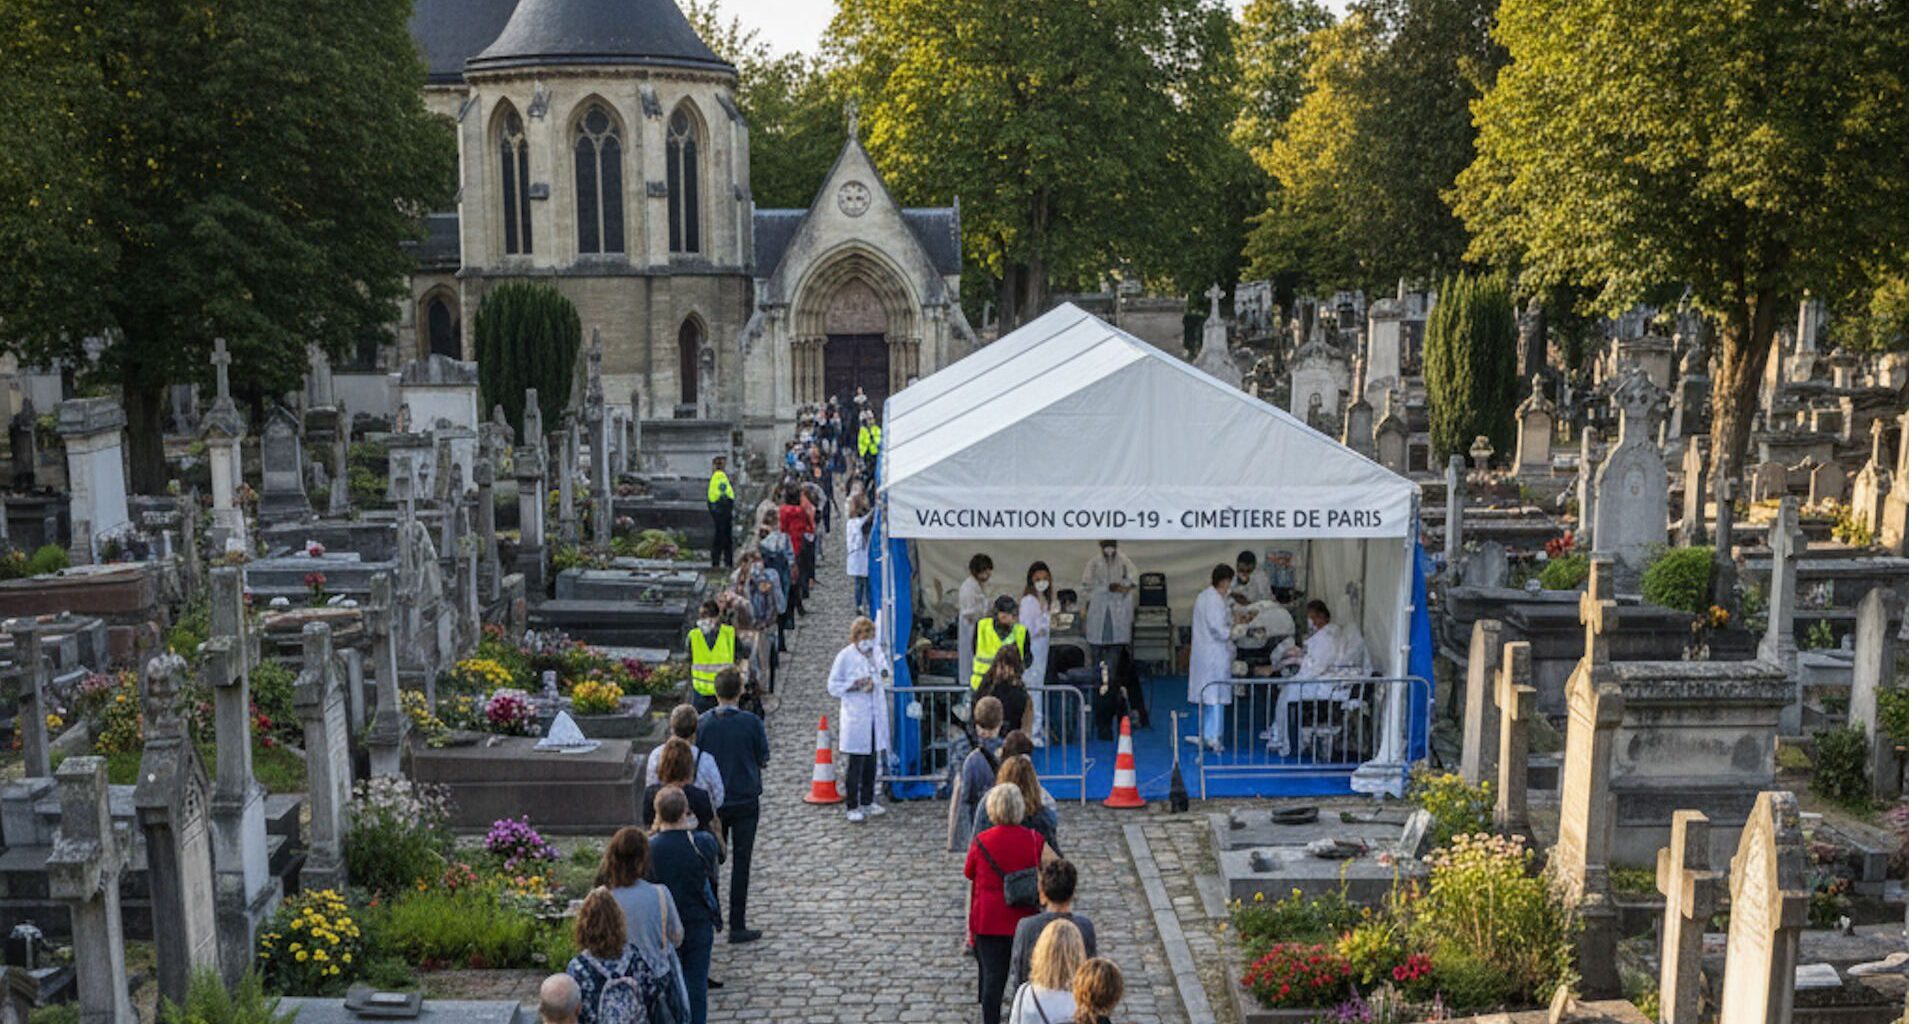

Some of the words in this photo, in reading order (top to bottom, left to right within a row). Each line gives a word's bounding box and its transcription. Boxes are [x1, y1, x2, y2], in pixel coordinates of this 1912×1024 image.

[915, 509, 1055, 528] VACCINATION
[1063, 510, 1160, 528] COVID-19
[1293, 509, 1321, 528] DE
[1327, 509, 1382, 528] PARIS
